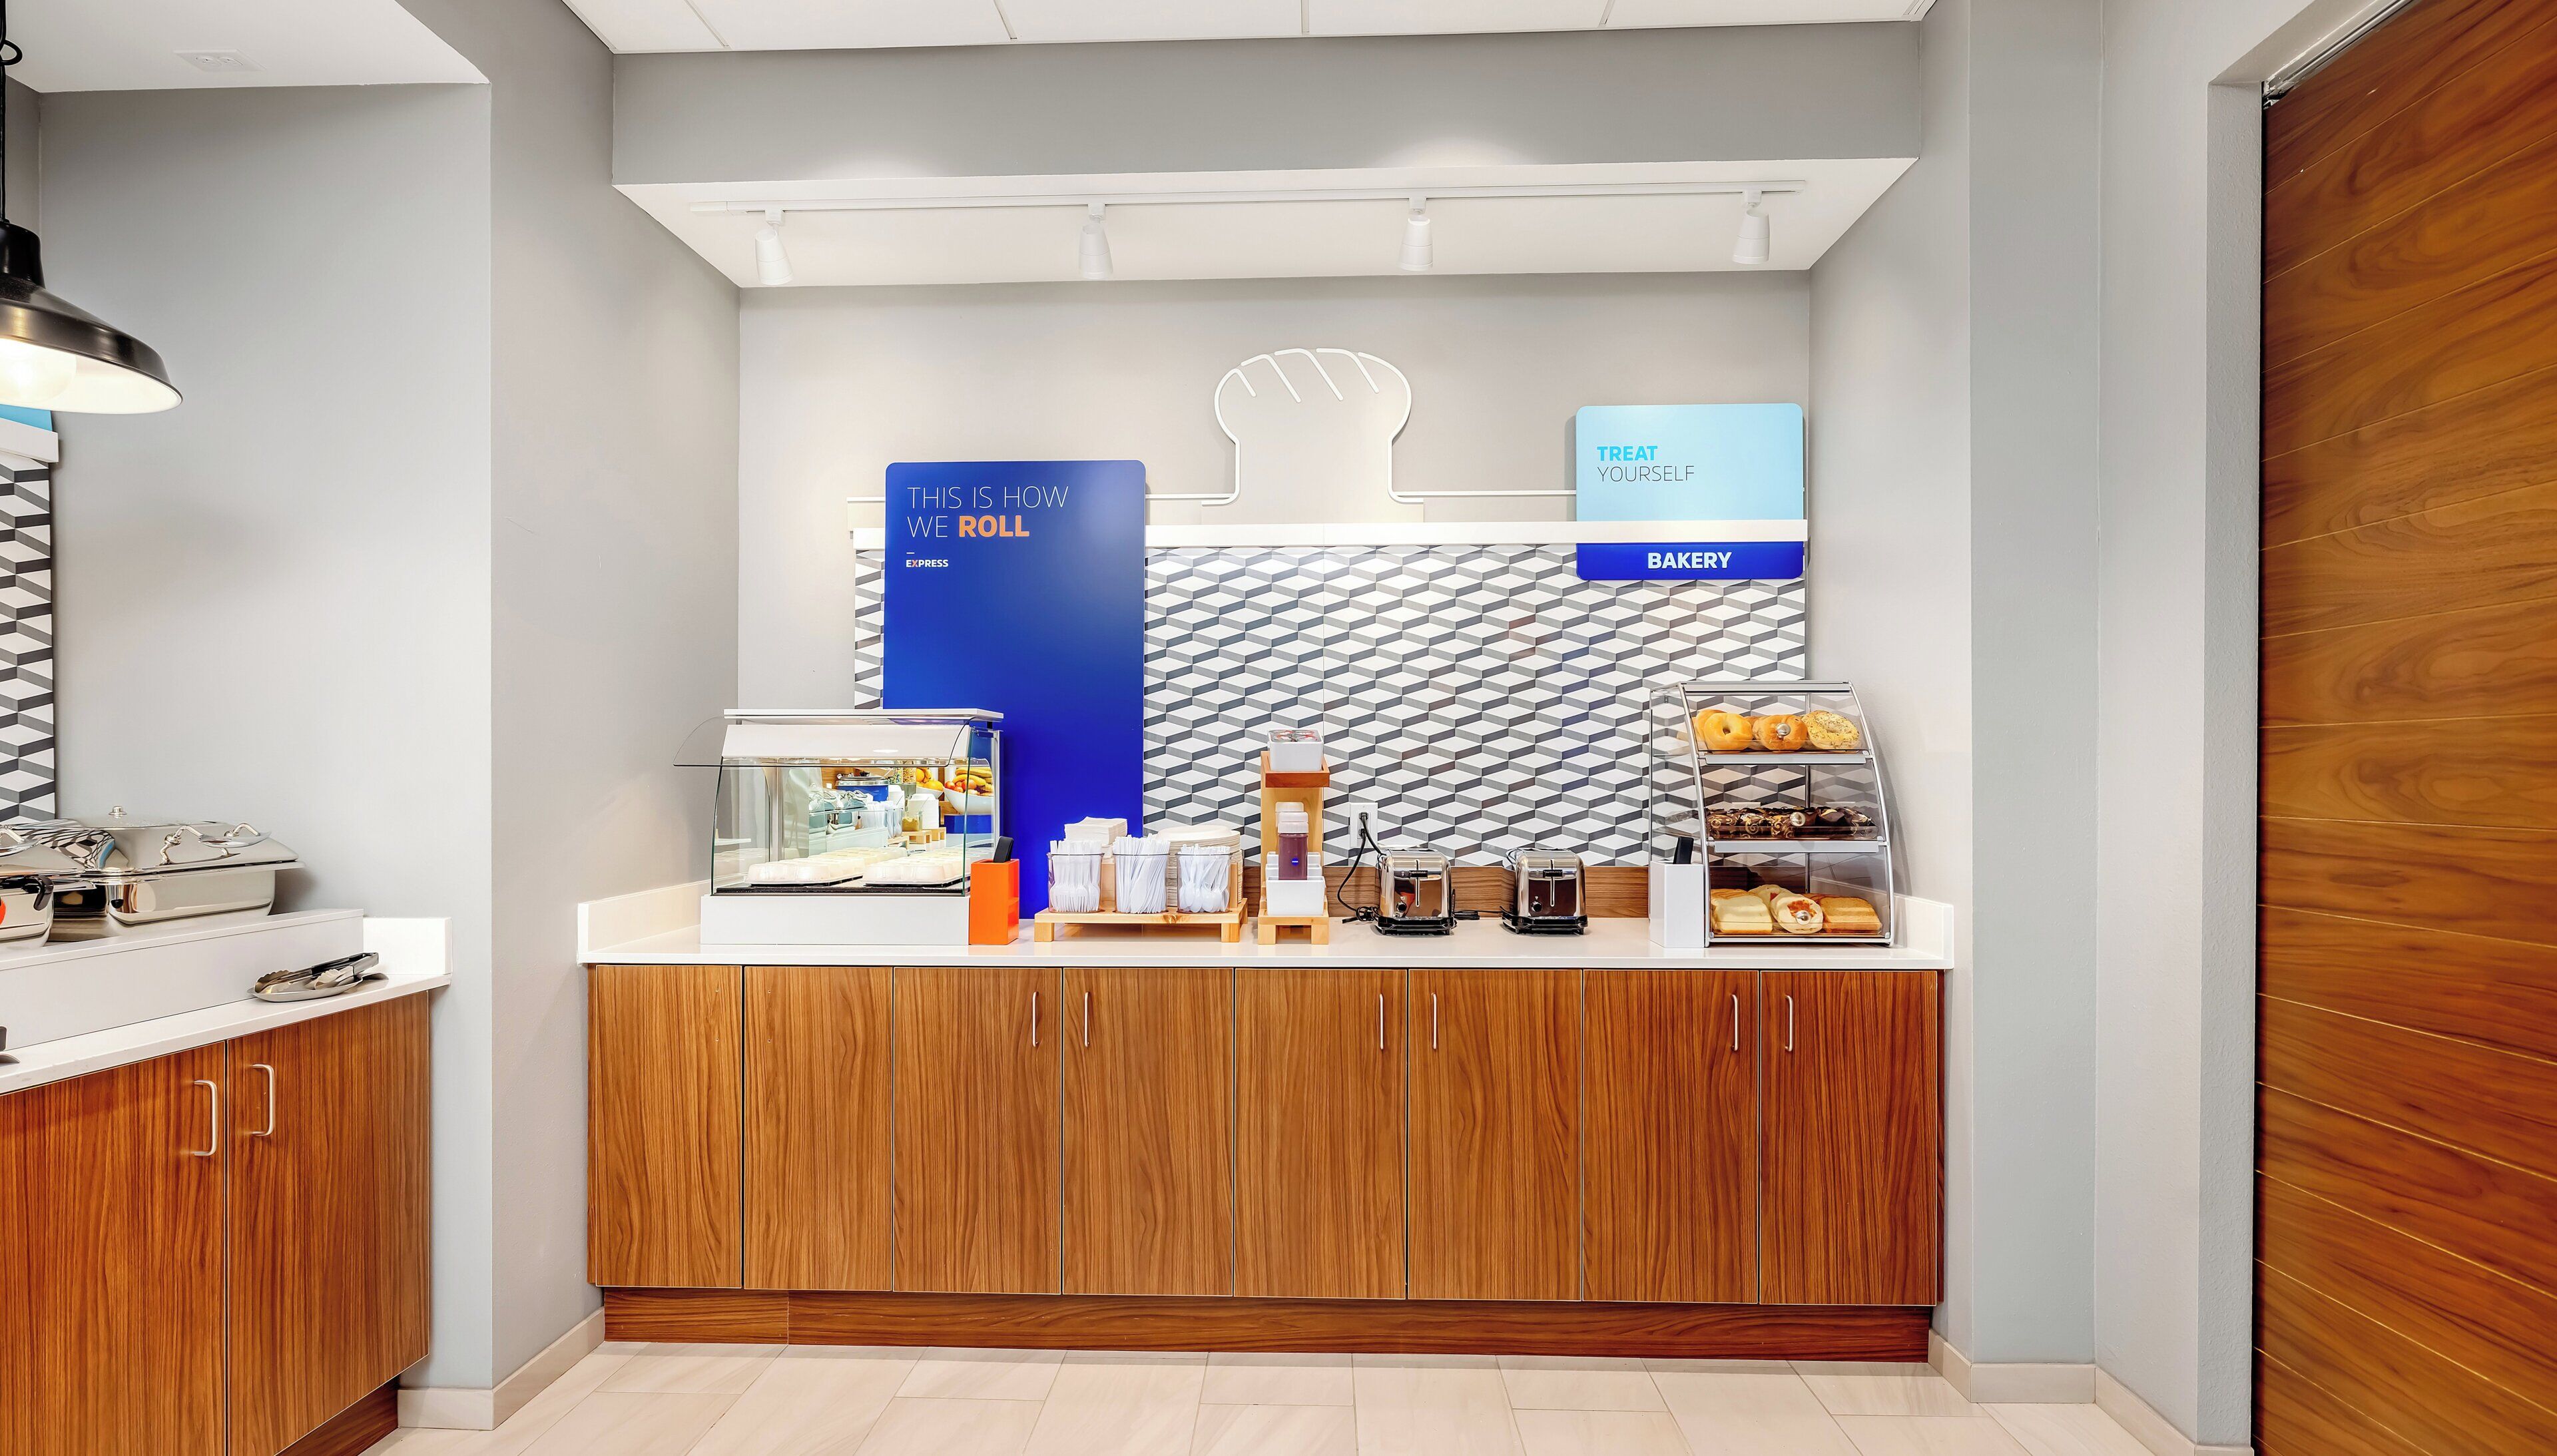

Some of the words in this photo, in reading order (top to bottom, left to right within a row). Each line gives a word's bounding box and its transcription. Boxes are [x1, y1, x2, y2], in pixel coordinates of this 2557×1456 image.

[1597, 445, 1658, 461] TREAT
[1597, 465, 1695, 482] YOURSELF
[907, 487, 962, 509] THIS
[973, 487, 993, 509] IS
[1004, 486, 1069, 509] HOW
[907, 516, 948, 538] WE
[959, 515, 1029, 537] ROLL
[906, 559, 949, 568] EXPRESS
[1647, 552, 1733, 569] BAKERY
